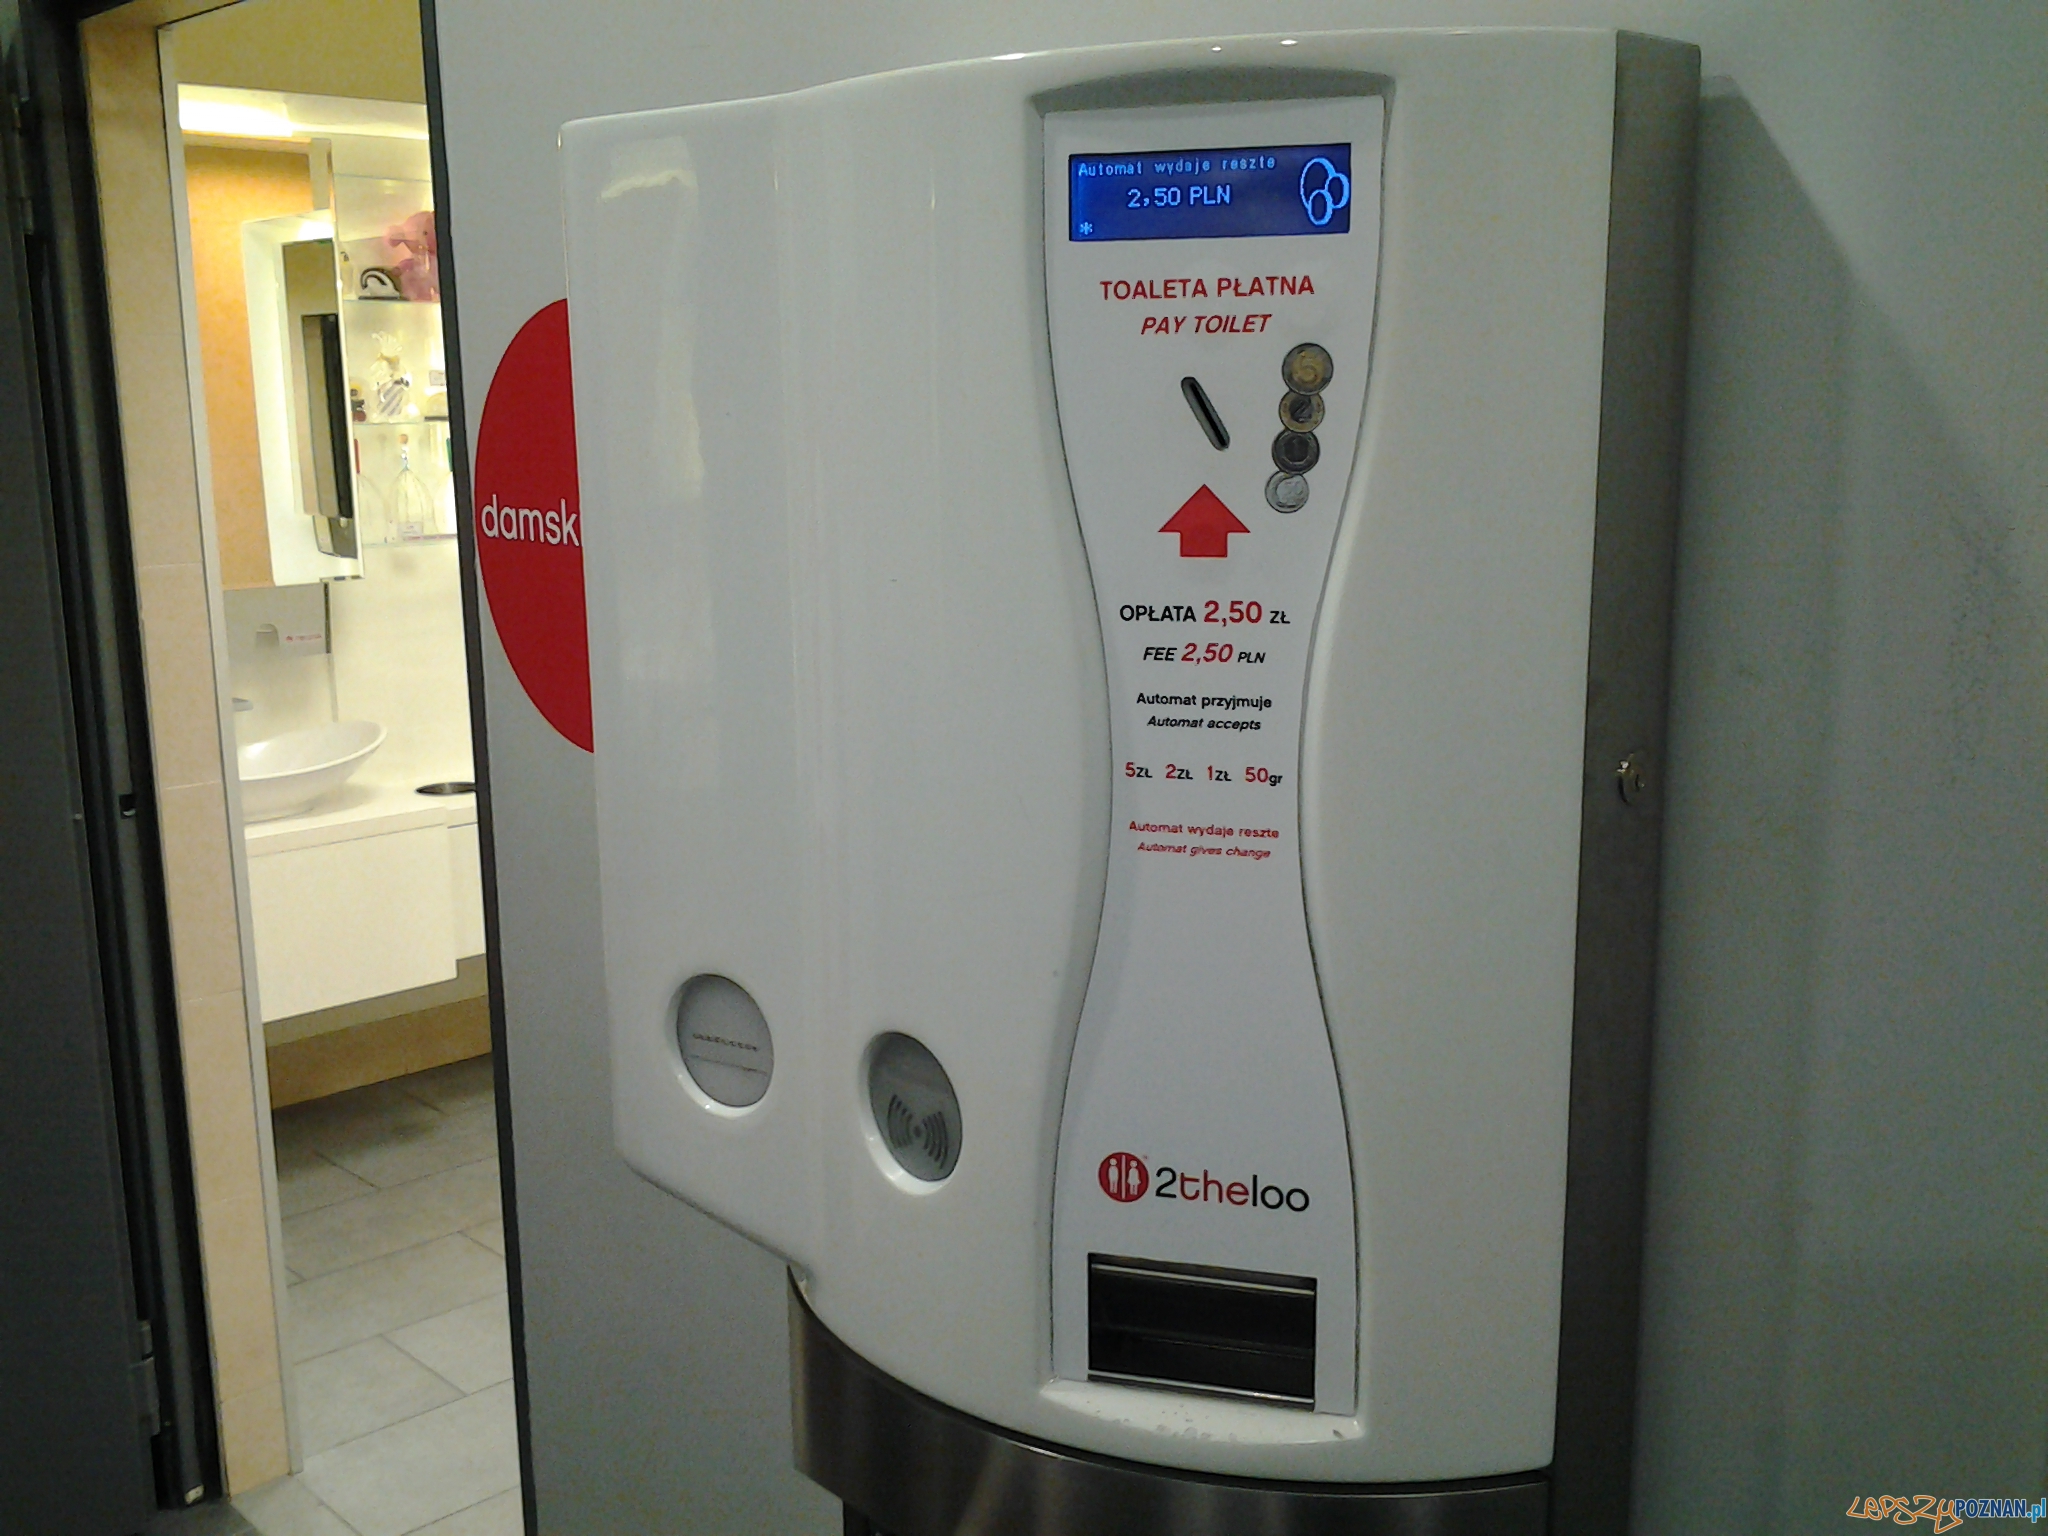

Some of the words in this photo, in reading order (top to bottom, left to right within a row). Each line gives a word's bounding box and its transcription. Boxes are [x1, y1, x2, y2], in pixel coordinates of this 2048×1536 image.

[1078, 161, 1143, 177] Automat
[1154, 158, 1211, 176] wydaje
[1127, 186, 1181, 208] 2,50
[1189, 184, 1231, 205] PLN
[1100, 278, 1207, 300] TOALETA
[1217, 275, 1315, 297] PŁATNA
[1141, 316, 1187, 335] PAY
[1195, 314, 1272, 333] TOILET
[1119, 605, 1197, 622] OPŁATA
[1203, 599, 1263, 627] 2,50
[1269, 610, 1291, 624] ZŁ
[1143, 646, 1178, 662] FEE
[1180, 642, 1233, 664] 2,50
[1237, 651, 1266, 664] PLN
[1136, 692, 1197, 706] Automat
[1201, 695, 1273, 711] przyjmuje
[1147, 716, 1204, 729] Automat
[1207, 719, 1261, 732] accepts
[1244, 767, 1283, 787] 50gr
[1129, 820, 1183, 834] Automat
[1187, 822, 1234, 839] wydaje
[1137, 841, 1187, 854] Automat
[1190, 845, 1223, 857] gives
[1226, 846, 1271, 861] change
[1155, 1166, 1310, 1212] 2theloo
